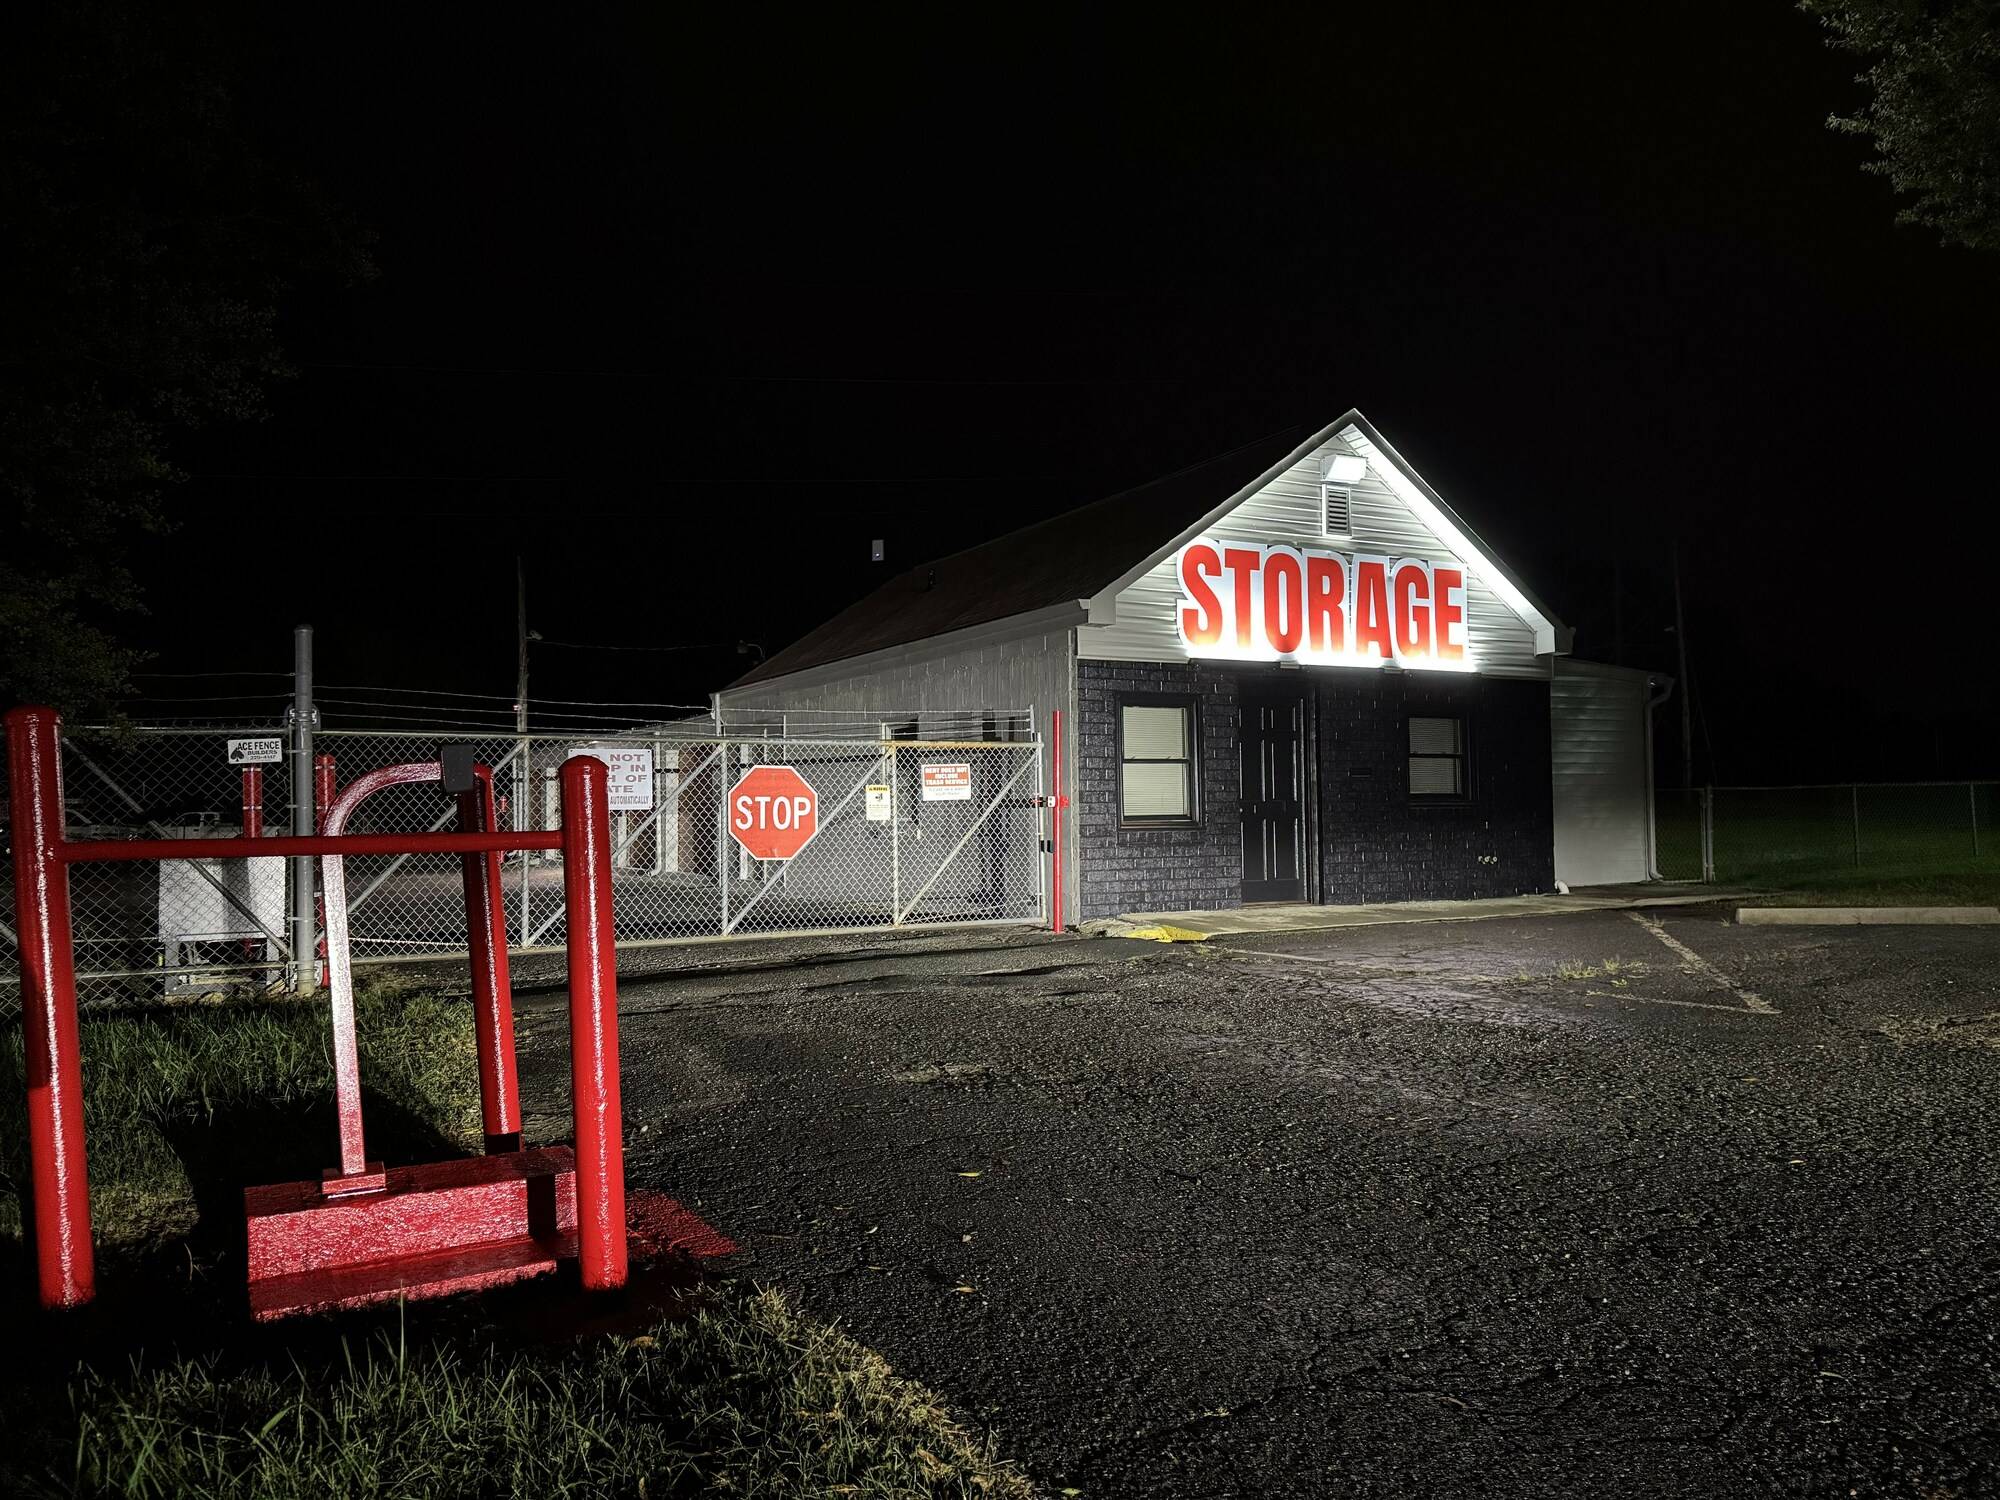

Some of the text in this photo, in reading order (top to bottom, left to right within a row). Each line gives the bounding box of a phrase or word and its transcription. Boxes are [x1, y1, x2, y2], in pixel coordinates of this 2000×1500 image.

[1182, 544, 1464, 661] STORAGE
[237, 740, 280, 751] ACE FENCE
[609, 753, 645, 762] NOT
[630, 764, 646, 772] IN
[625, 774, 648, 783] OF
[609, 795, 650, 805] AUTOMATICALLY
[735, 795, 812, 830] STOP
